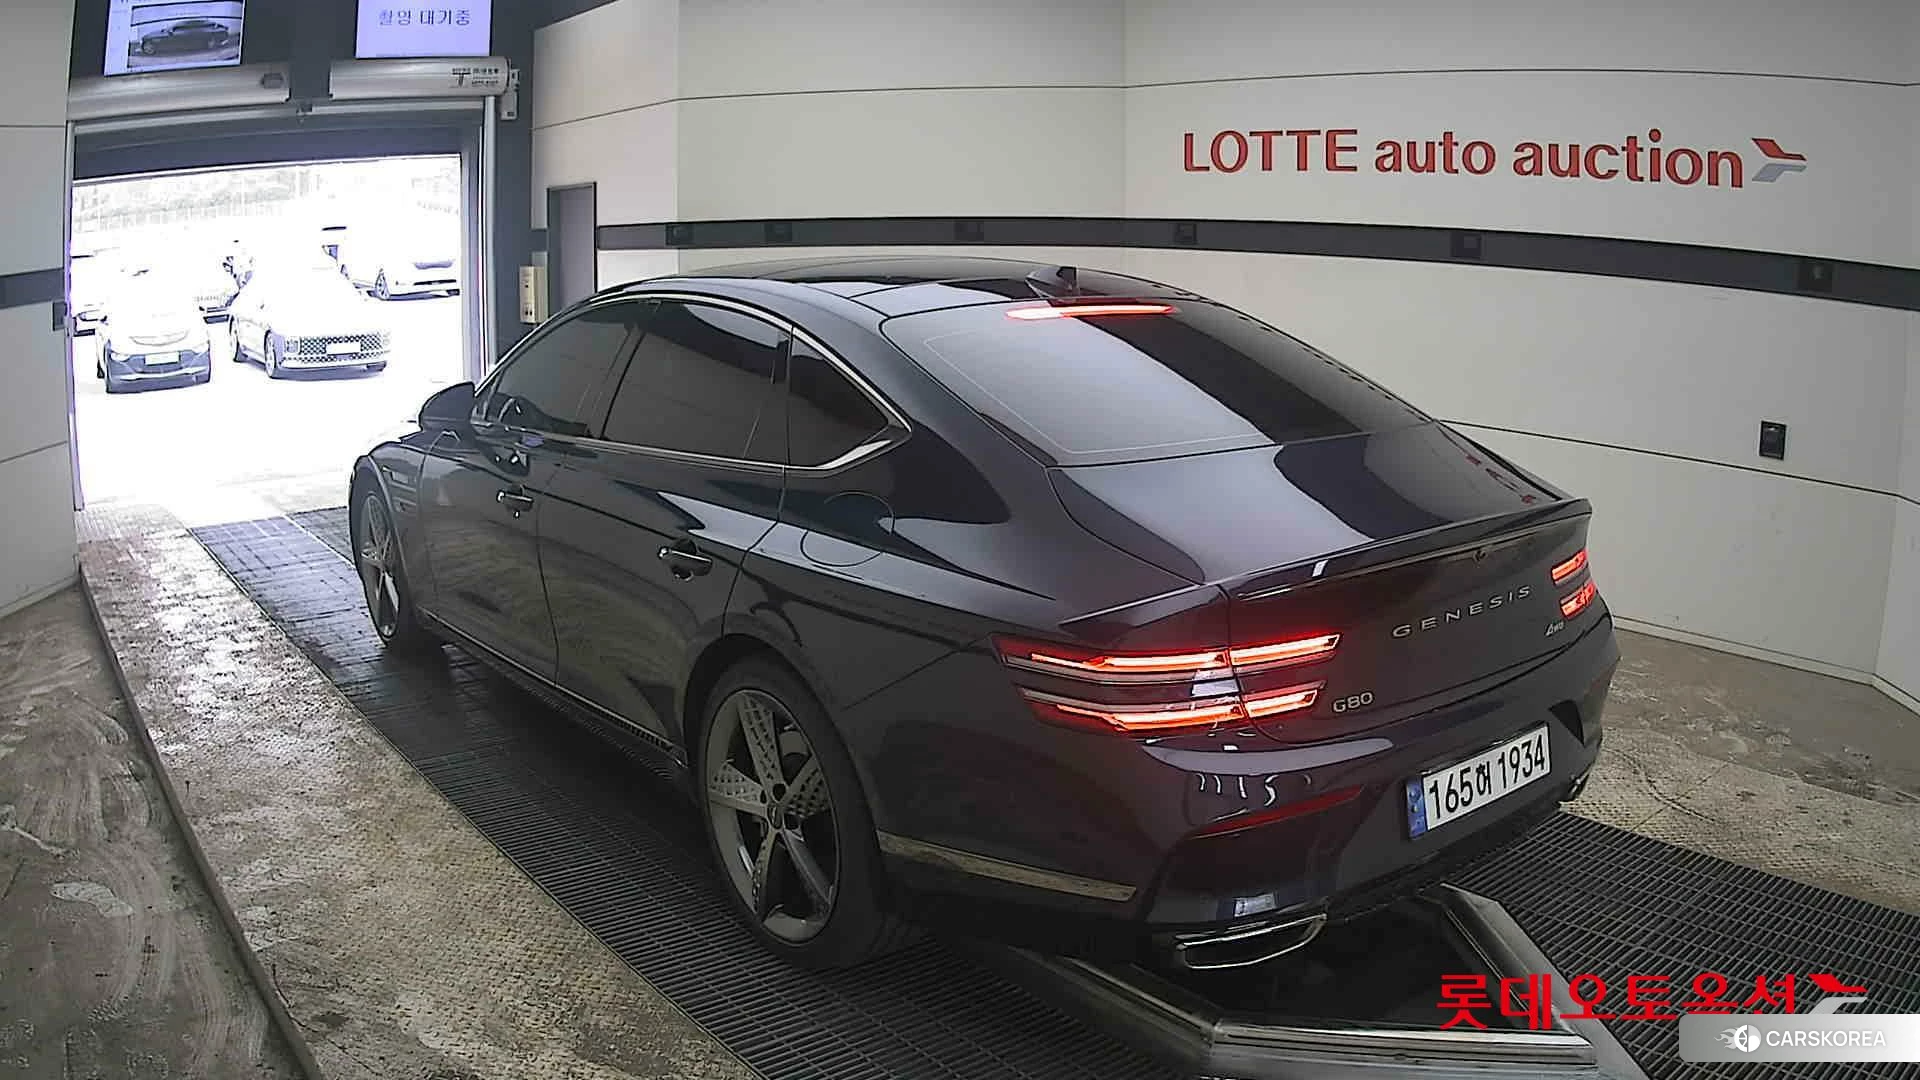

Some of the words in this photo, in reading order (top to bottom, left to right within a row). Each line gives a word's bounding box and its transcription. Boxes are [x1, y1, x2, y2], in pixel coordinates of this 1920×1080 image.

[420, 8, 471, 26] 대기중
[1183, 129, 1358, 173] LOTTE
[1375, 131, 1497, 175] auto
[1512, 128, 1743, 188] auction
[1392, 585, 1531, 638] GENESIS
[1332, 692, 1374, 713] G80
[1428, 760, 1492, 820] 165허
[1497, 733, 1545, 790] 1934
